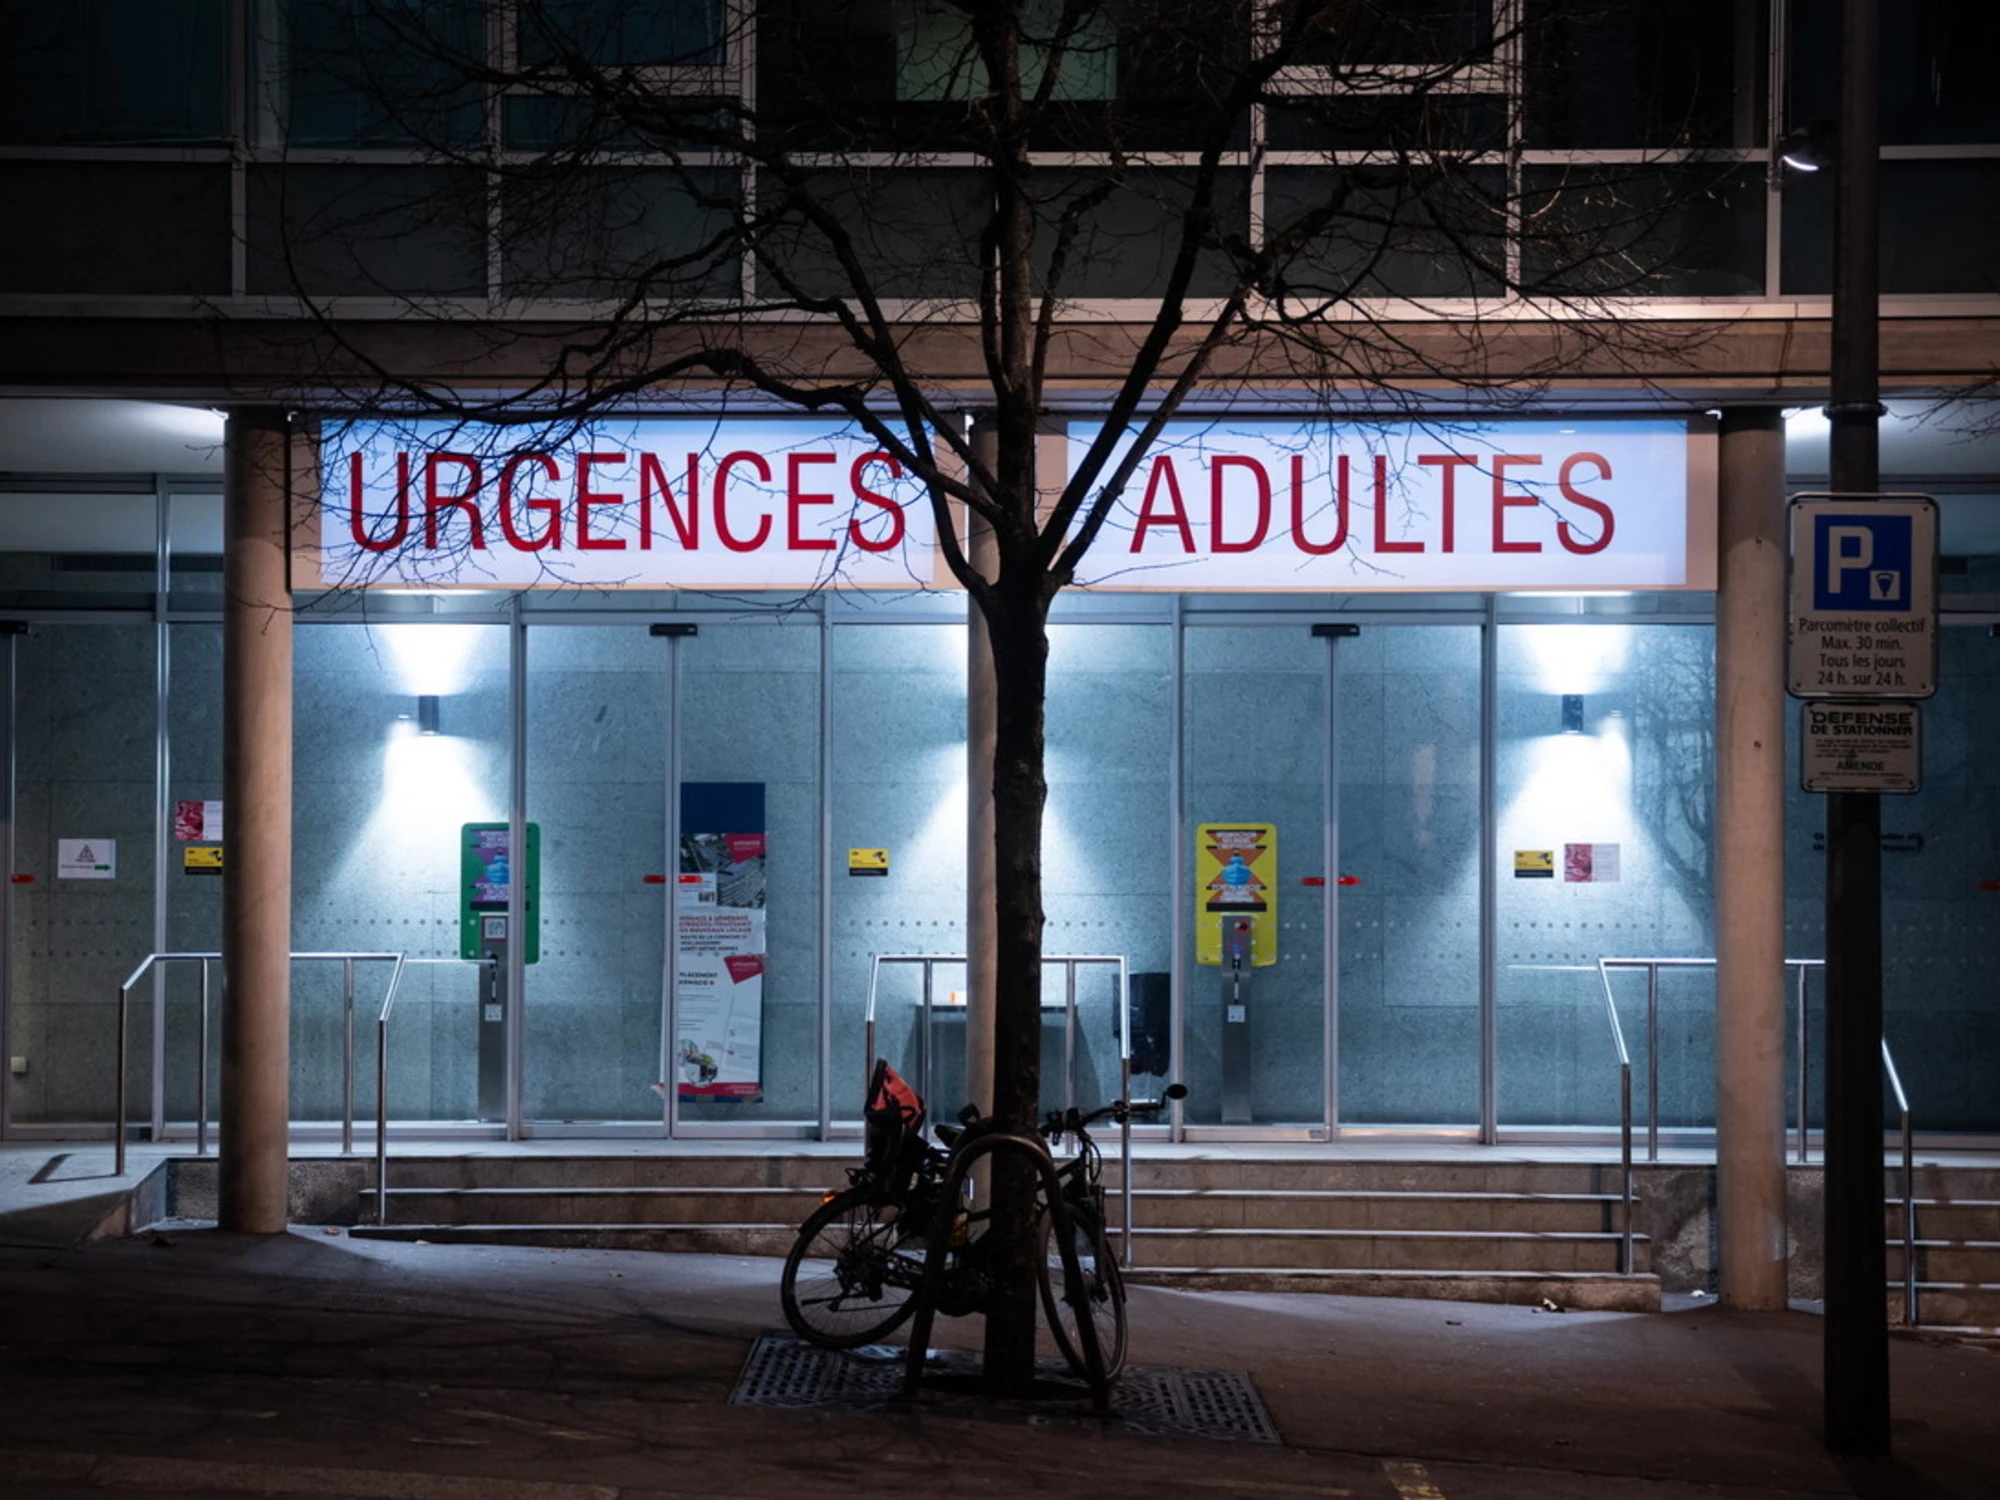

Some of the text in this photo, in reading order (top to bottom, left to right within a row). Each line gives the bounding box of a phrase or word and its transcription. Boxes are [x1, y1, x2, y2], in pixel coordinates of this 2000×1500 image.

[350, 451, 1615, 555] URGENCES ADULTES
[1828, 526, 1873, 594] P
[1799, 618, 1925, 632] Parcomètre collectif
[1821, 636, 1903, 650] Max. 30 min.
[1819, 653, 1905, 671] Tous les jours
[1817, 671, 1907, 685] 24 h. sur 24 h.
[1811, 726, 1913, 736] DE STATIONNER
